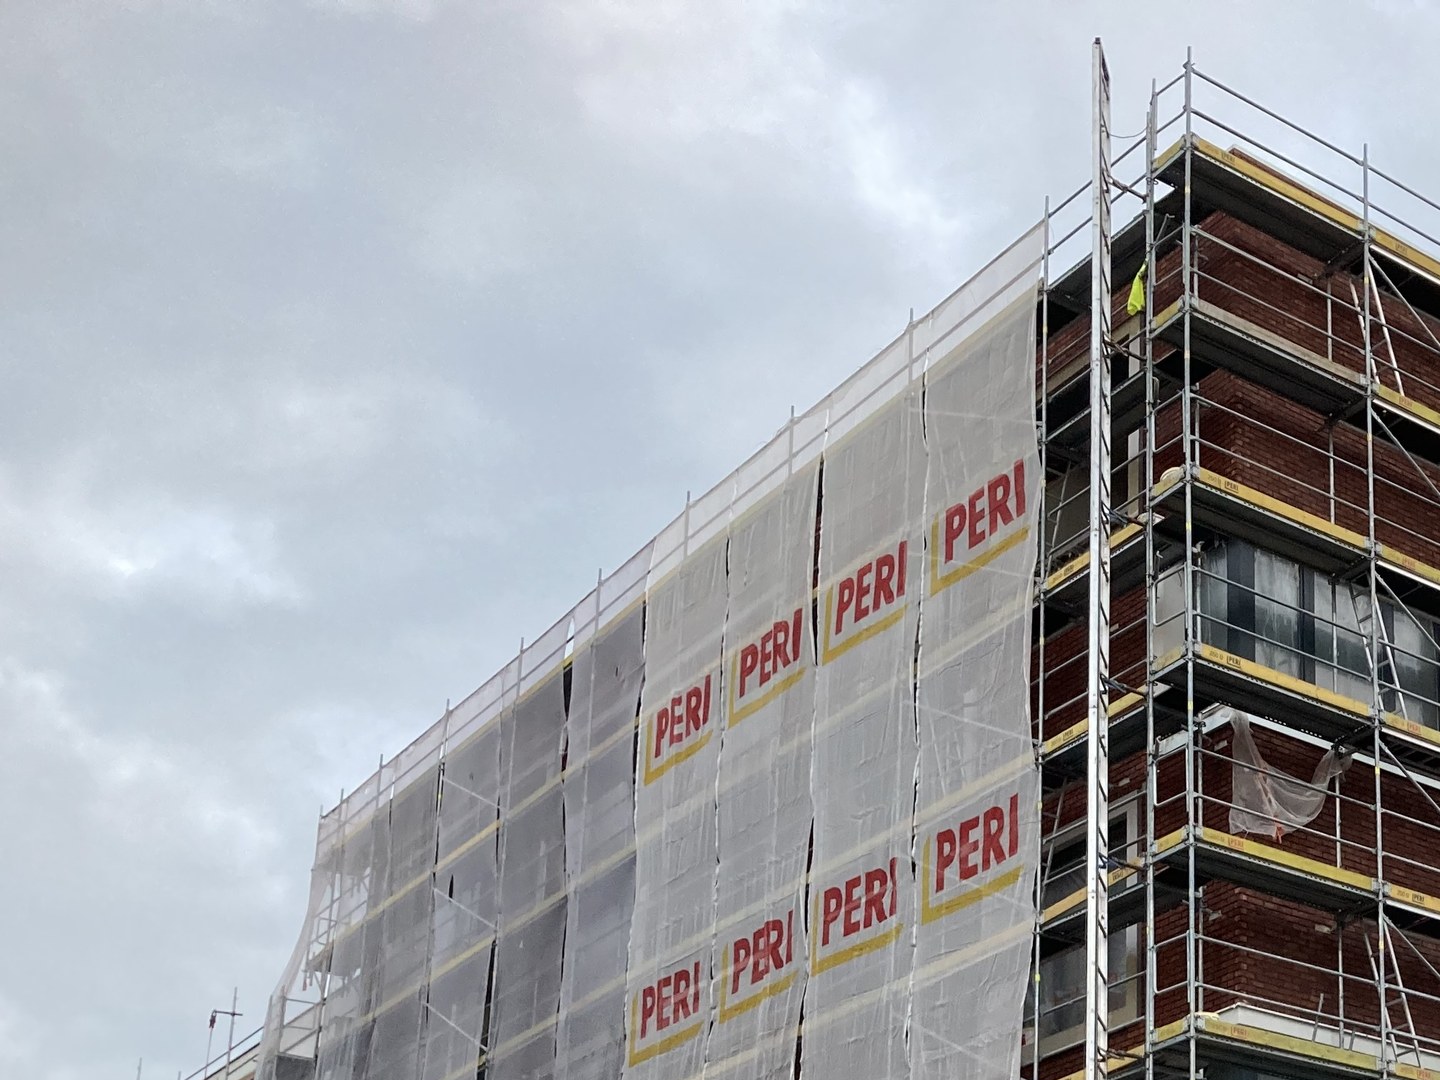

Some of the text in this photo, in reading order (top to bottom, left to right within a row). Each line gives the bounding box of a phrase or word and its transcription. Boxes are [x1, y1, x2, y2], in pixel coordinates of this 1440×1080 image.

[944, 459, 1026, 564] PERI
[834, 540, 908, 635] PERI
[738, 608, 803, 698] PERI
[654, 674, 712, 758] PERI
[935, 792, 1019, 893] PERI
[821, 857, 899, 947] PERI
[731, 910, 794, 994] PERI
[639, 961, 701, 1040] PERI
